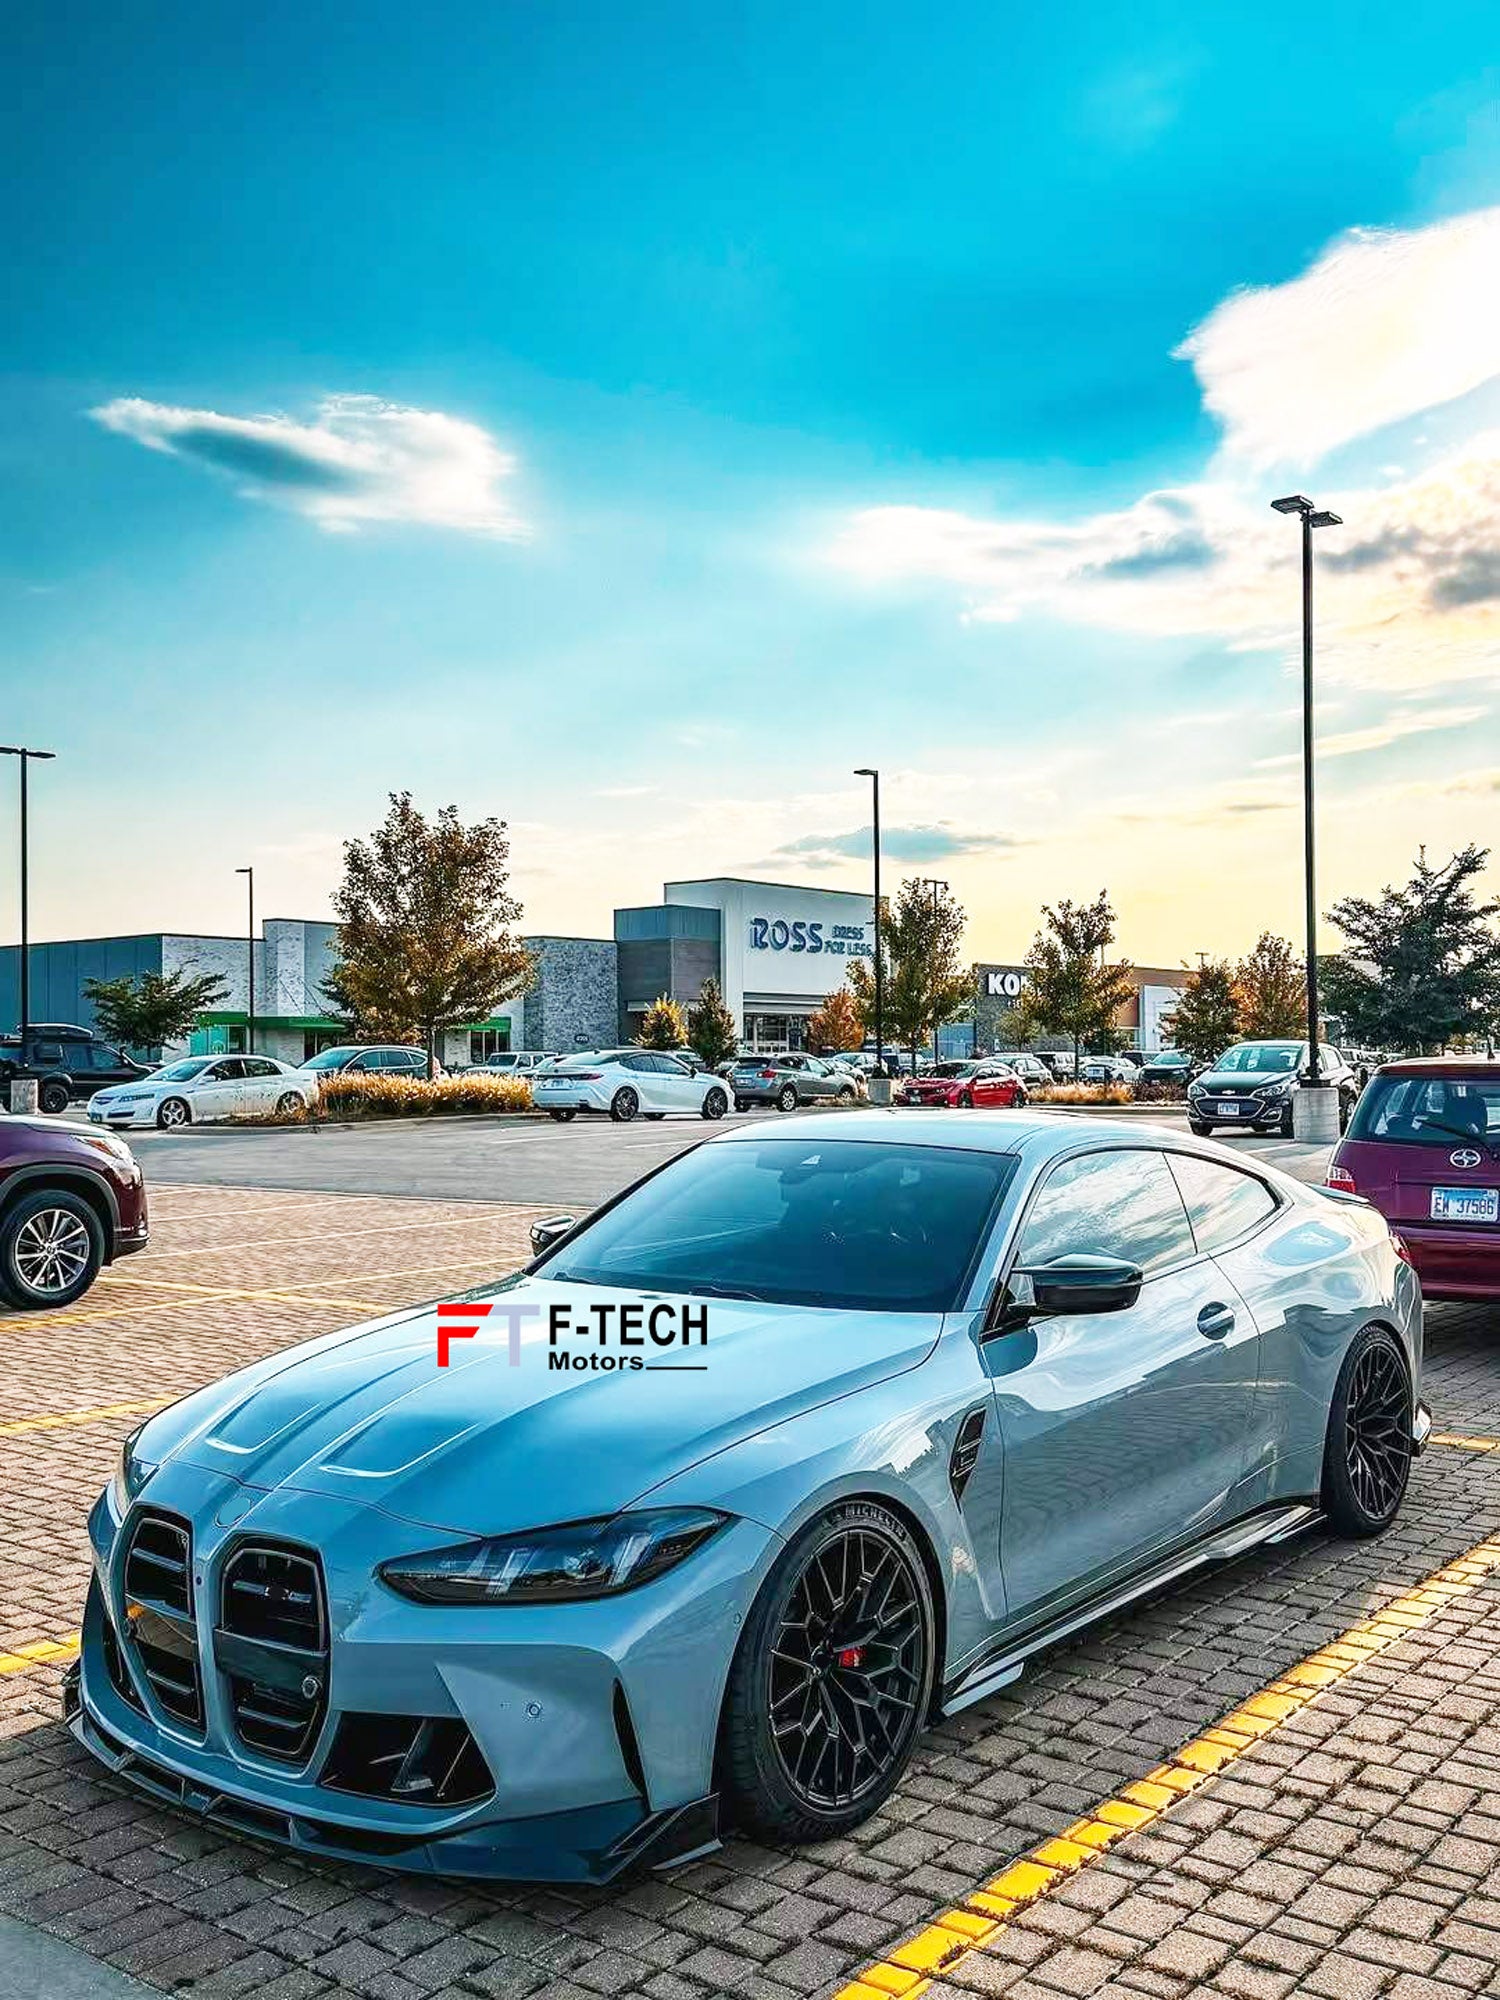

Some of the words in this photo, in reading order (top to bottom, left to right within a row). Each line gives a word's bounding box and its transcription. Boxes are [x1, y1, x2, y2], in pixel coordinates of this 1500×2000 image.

[750, 917, 823, 953] ROSS
[832, 925, 865, 940] DRESS
[824, 940, 846, 955] FOR
[847, 942, 874, 957] LESS
[845, 1505, 905, 1538] MICHELIN
